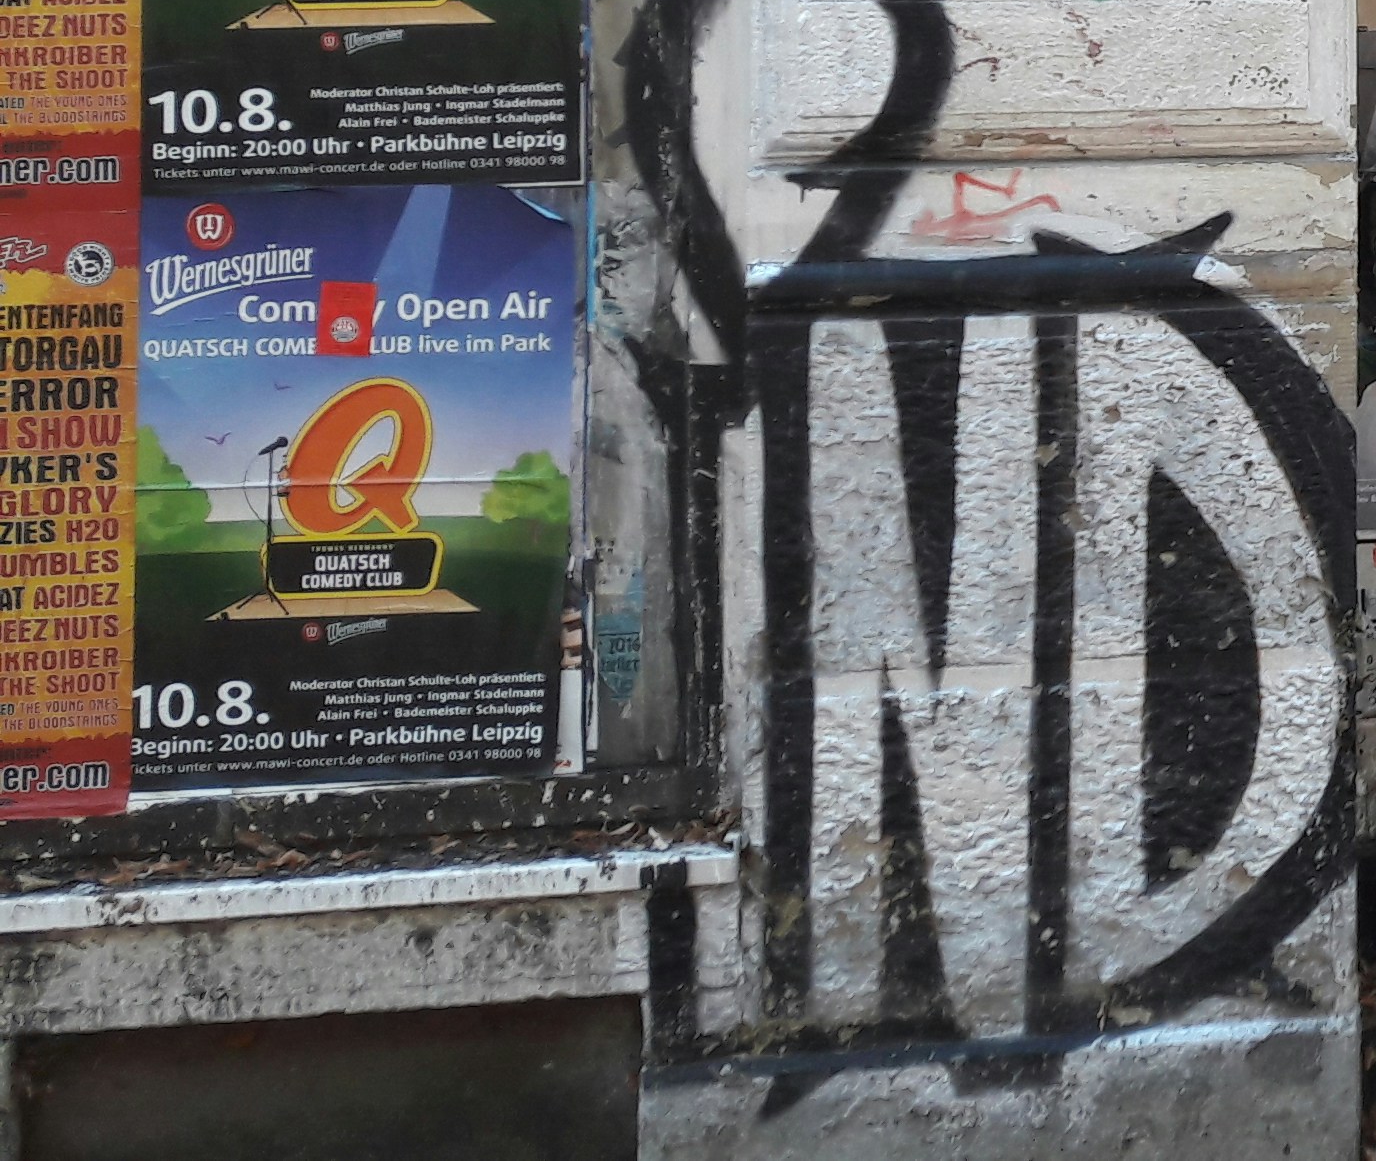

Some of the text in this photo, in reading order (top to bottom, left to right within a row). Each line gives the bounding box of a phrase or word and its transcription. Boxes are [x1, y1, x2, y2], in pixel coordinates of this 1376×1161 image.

[311, 86, 373, 99] Moderator
[425, 83, 494, 97] Schulte-Loh
[148, 87, 292, 135] 10.8.
[345, 96, 565, 115] Matthias Jung Ingmar Stadelmann
[338, 111, 565, 128] Alain Frei Bademeister Schaluppke
[153, 130, 567, 163] Beginn: 20:00 Uhr Parkbühne Leipzig
[241, 157, 466, 176] www.mawi-concert.de Hotline
[397, 291, 552, 329] Open Air
[220, 721, 543, 752] 20:00 Uhr Parkbühne Leipzig
